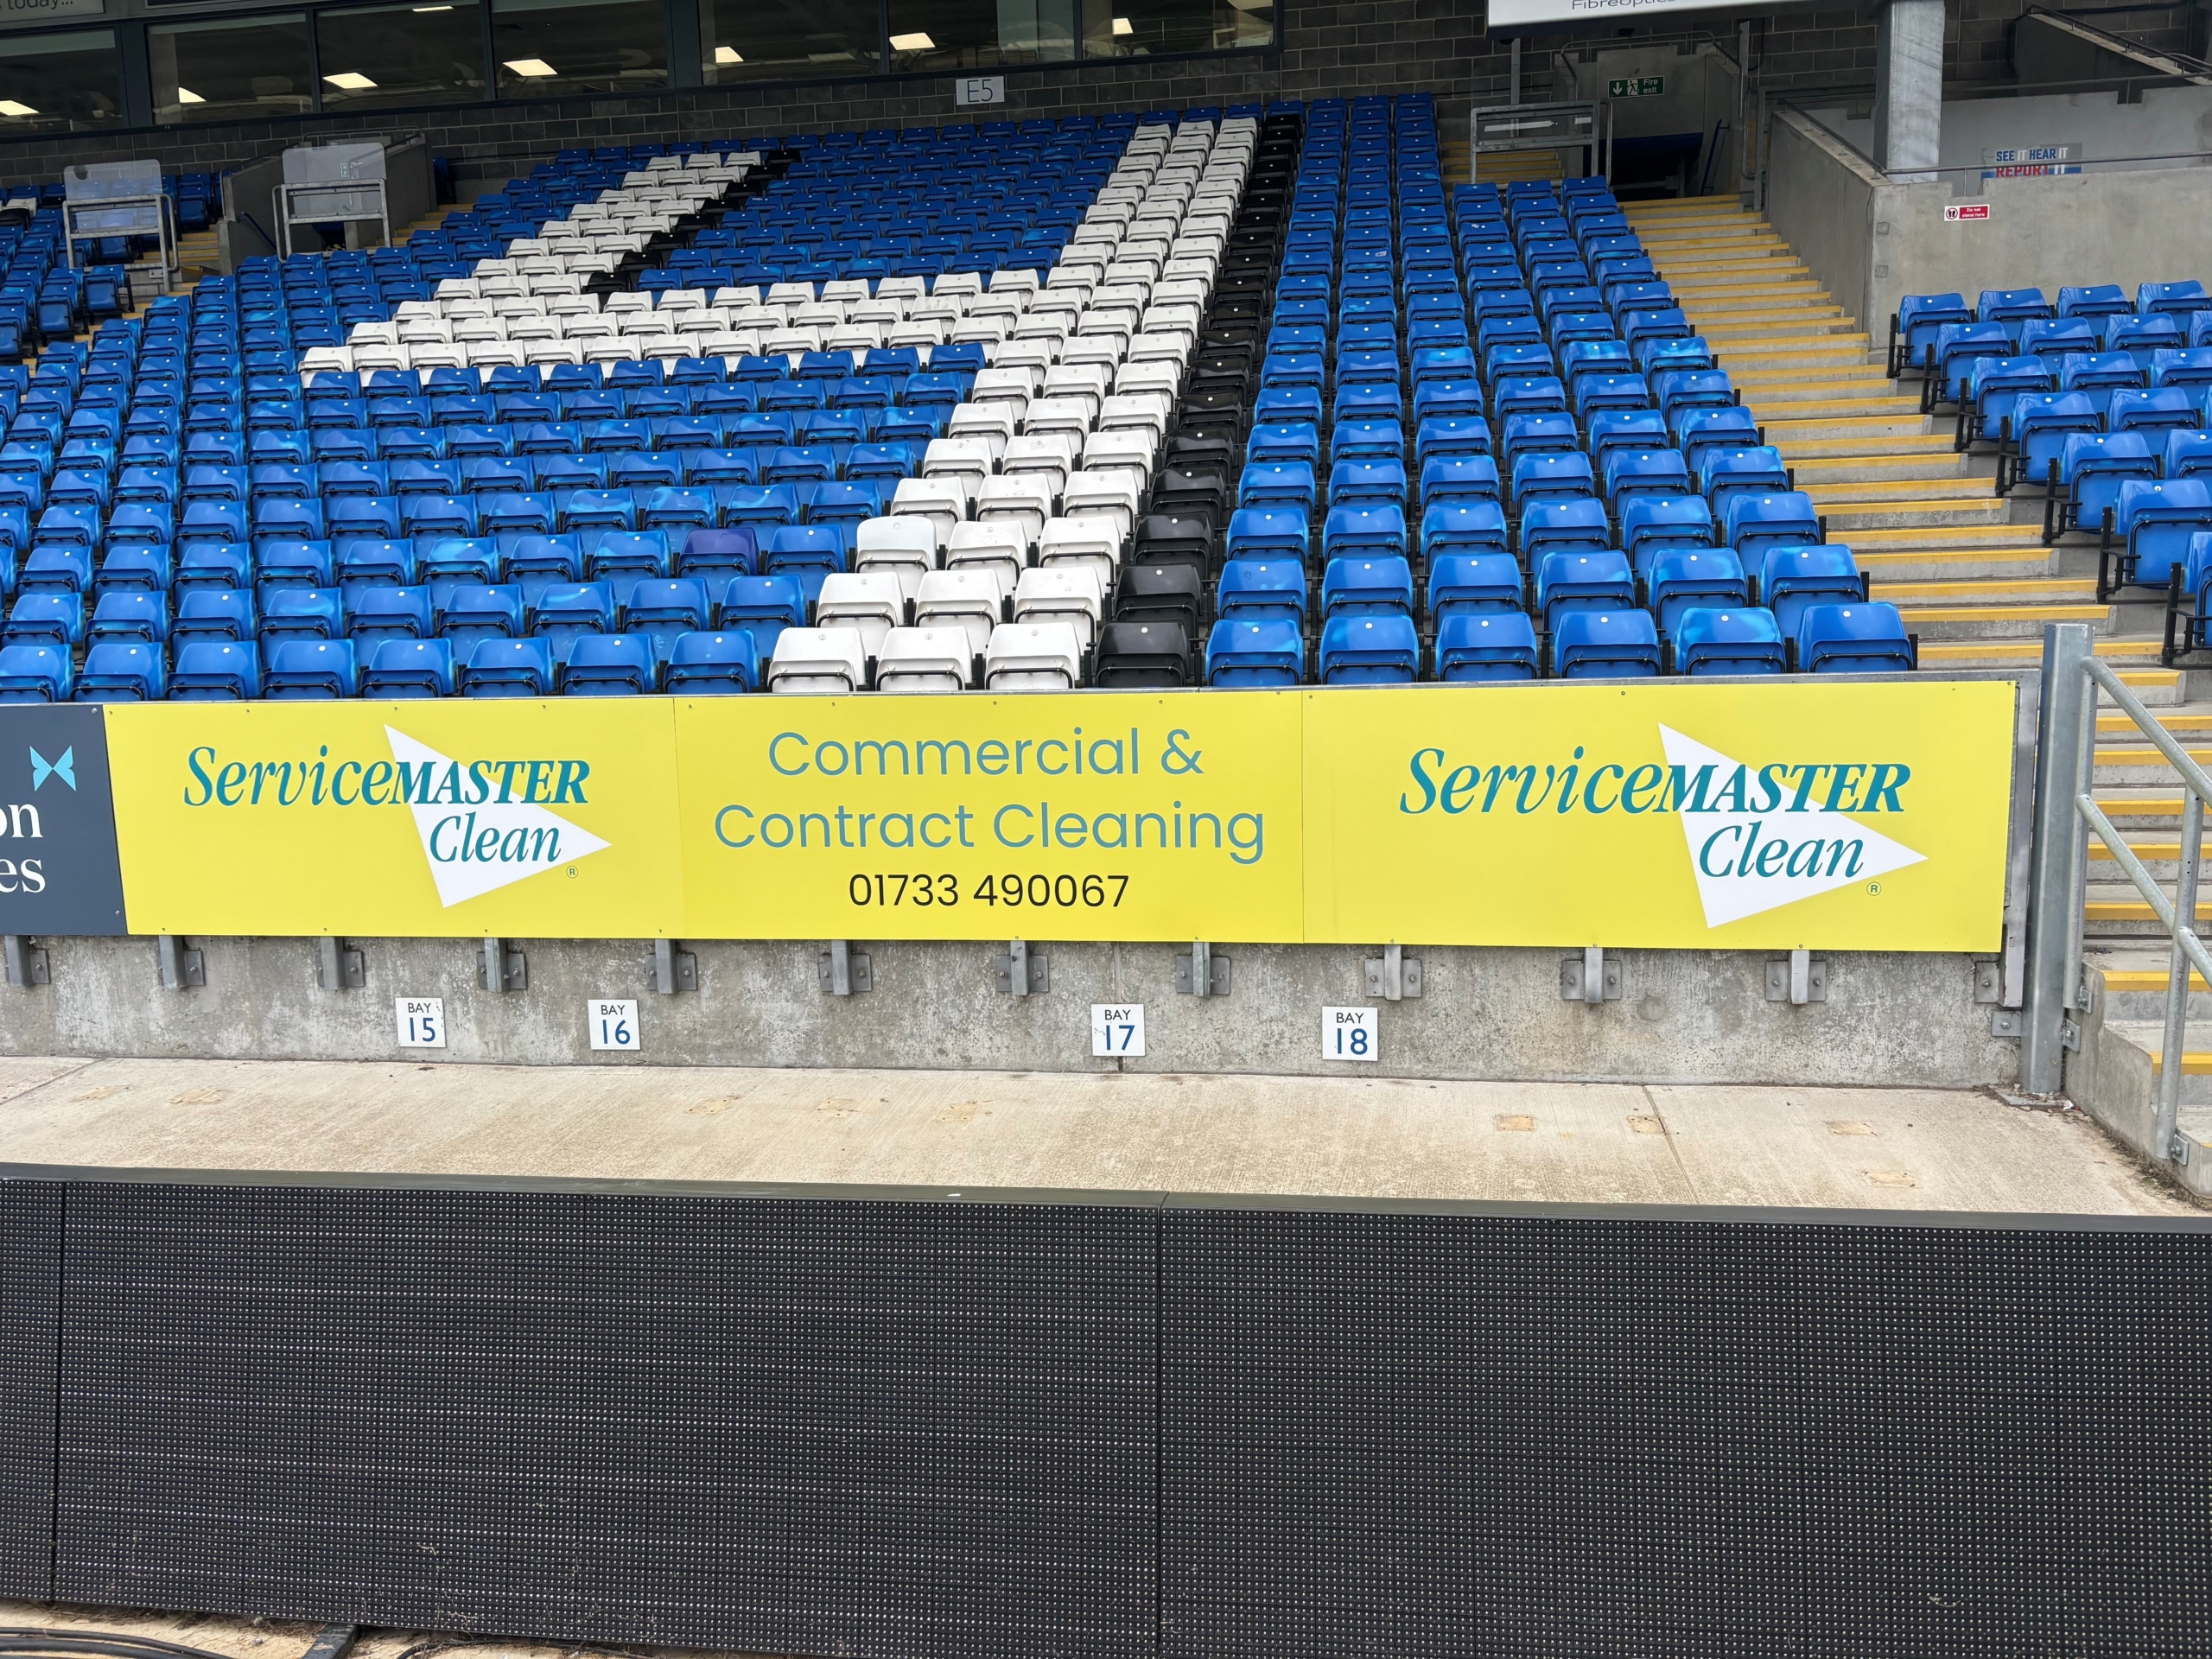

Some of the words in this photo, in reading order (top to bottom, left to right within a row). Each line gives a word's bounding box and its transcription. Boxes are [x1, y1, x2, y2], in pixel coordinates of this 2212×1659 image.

[967, 79, 994, 103] E5
[1996, 150, 2015, 162] SEE
[2018, 149, 2027, 162] IT
[2029, 148, 2056, 160] HEAR
[2058, 147, 2069, 159] IT
[769, 727, 1139, 776] Commercial
[1160, 728, 1204, 775] &
[184, 744, 590, 807] ServiceMASTER
[1399, 746, 1911, 815] ServiceMASTER
[0, 804, 43, 838] n
[715, 804, 975, 849] Contract
[994, 800, 1264, 865] Cleaning
[429, 810, 562, 862] Clean
[1699, 820, 1864, 878] Clean
[849, 874, 959, 906] 01733
[973, 874, 1129, 907] 490067
[408, 1002, 431, 1014] BAY
[601, 1004, 626, 1015] BAY
[1104, 1009, 1131, 1020] BAY
[1336, 1013, 1364, 1024] BAY
[410, 1017, 435, 1042] 15
[602, 1019, 631, 1045] 16
[1106, 1025, 1135, 1051] 17
[1337, 1027, 1368, 1055] 18
